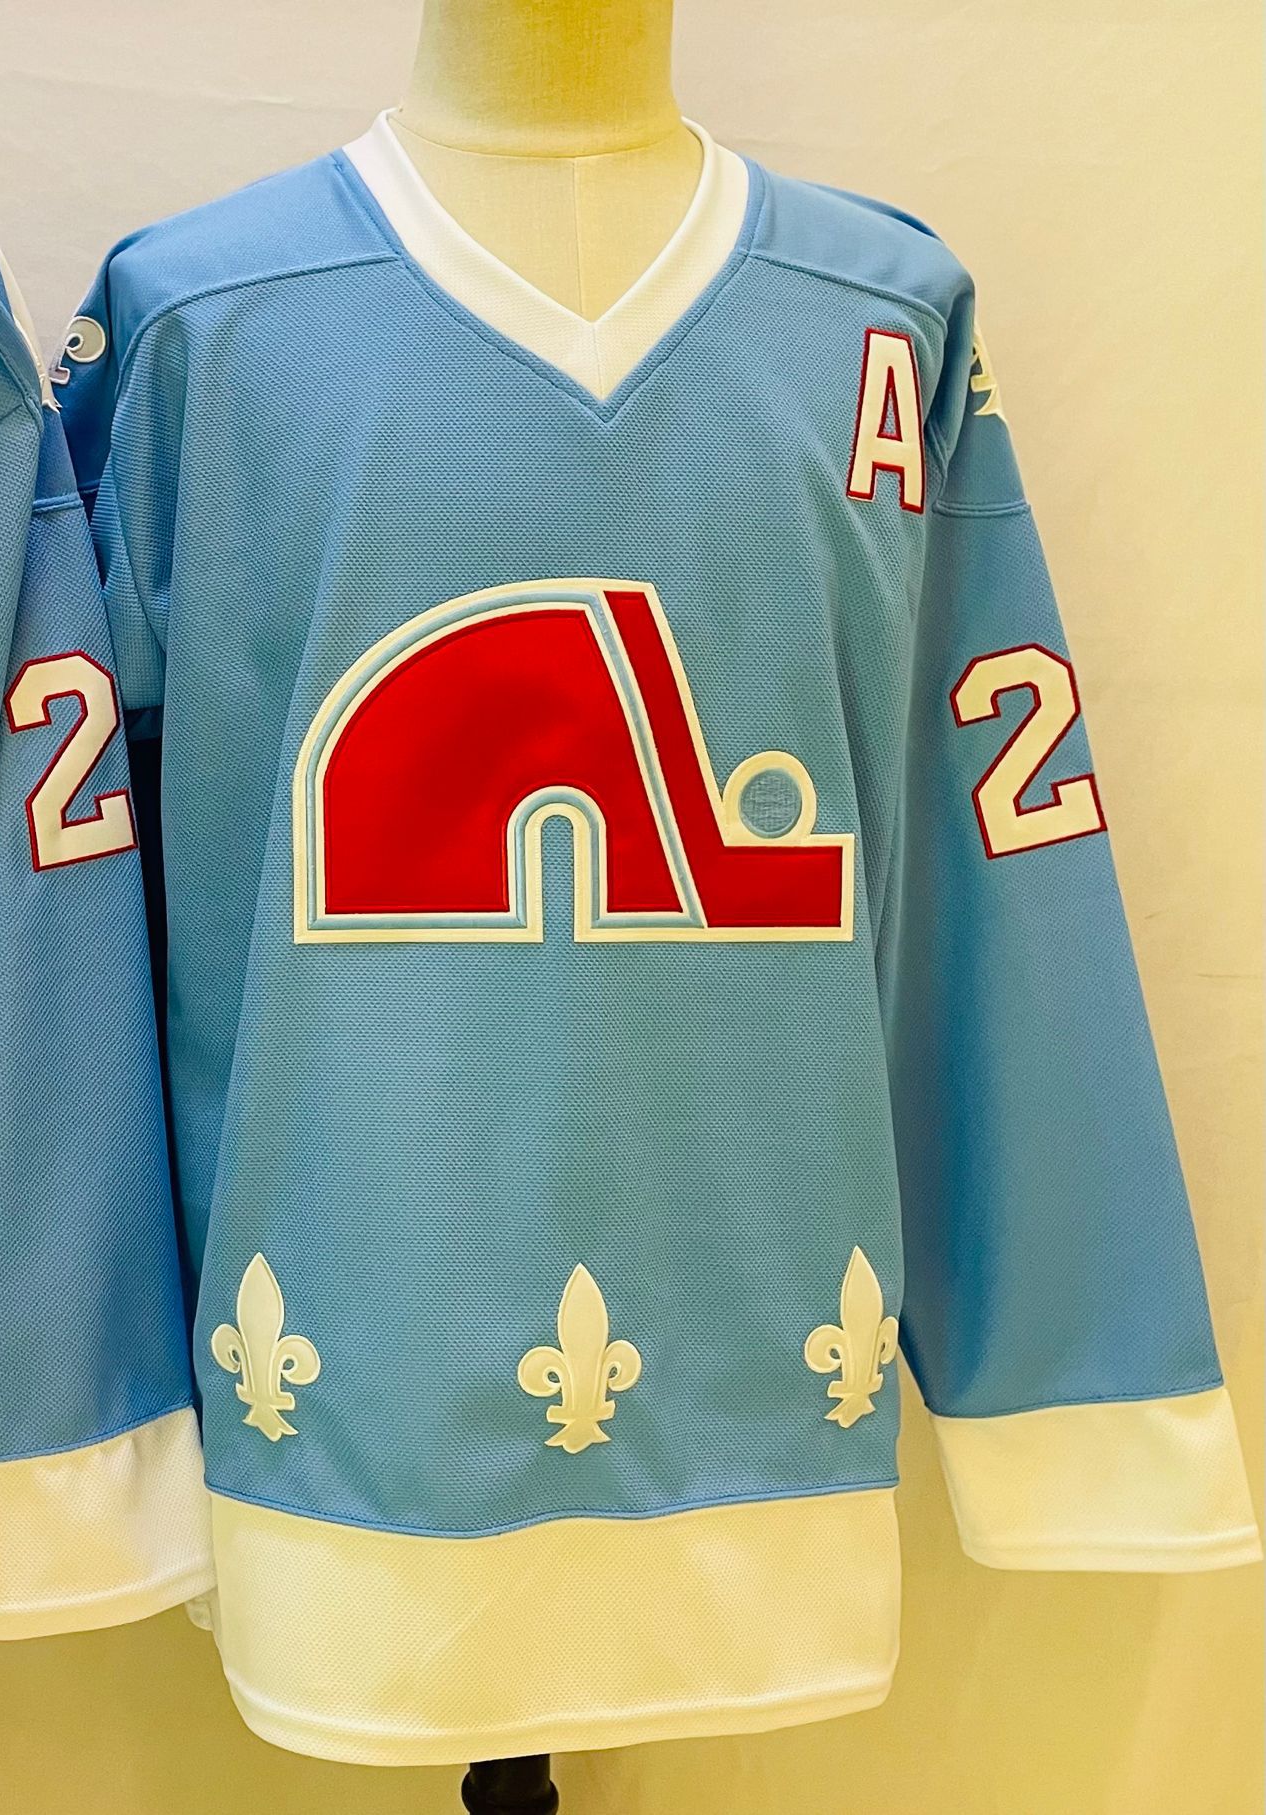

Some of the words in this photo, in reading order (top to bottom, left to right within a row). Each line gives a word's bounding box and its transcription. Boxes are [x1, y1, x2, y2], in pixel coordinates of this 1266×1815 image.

[846, 327, 927, 515] A
[3, 649, 140, 873] 2
[949, 642, 1108, 860] 2
